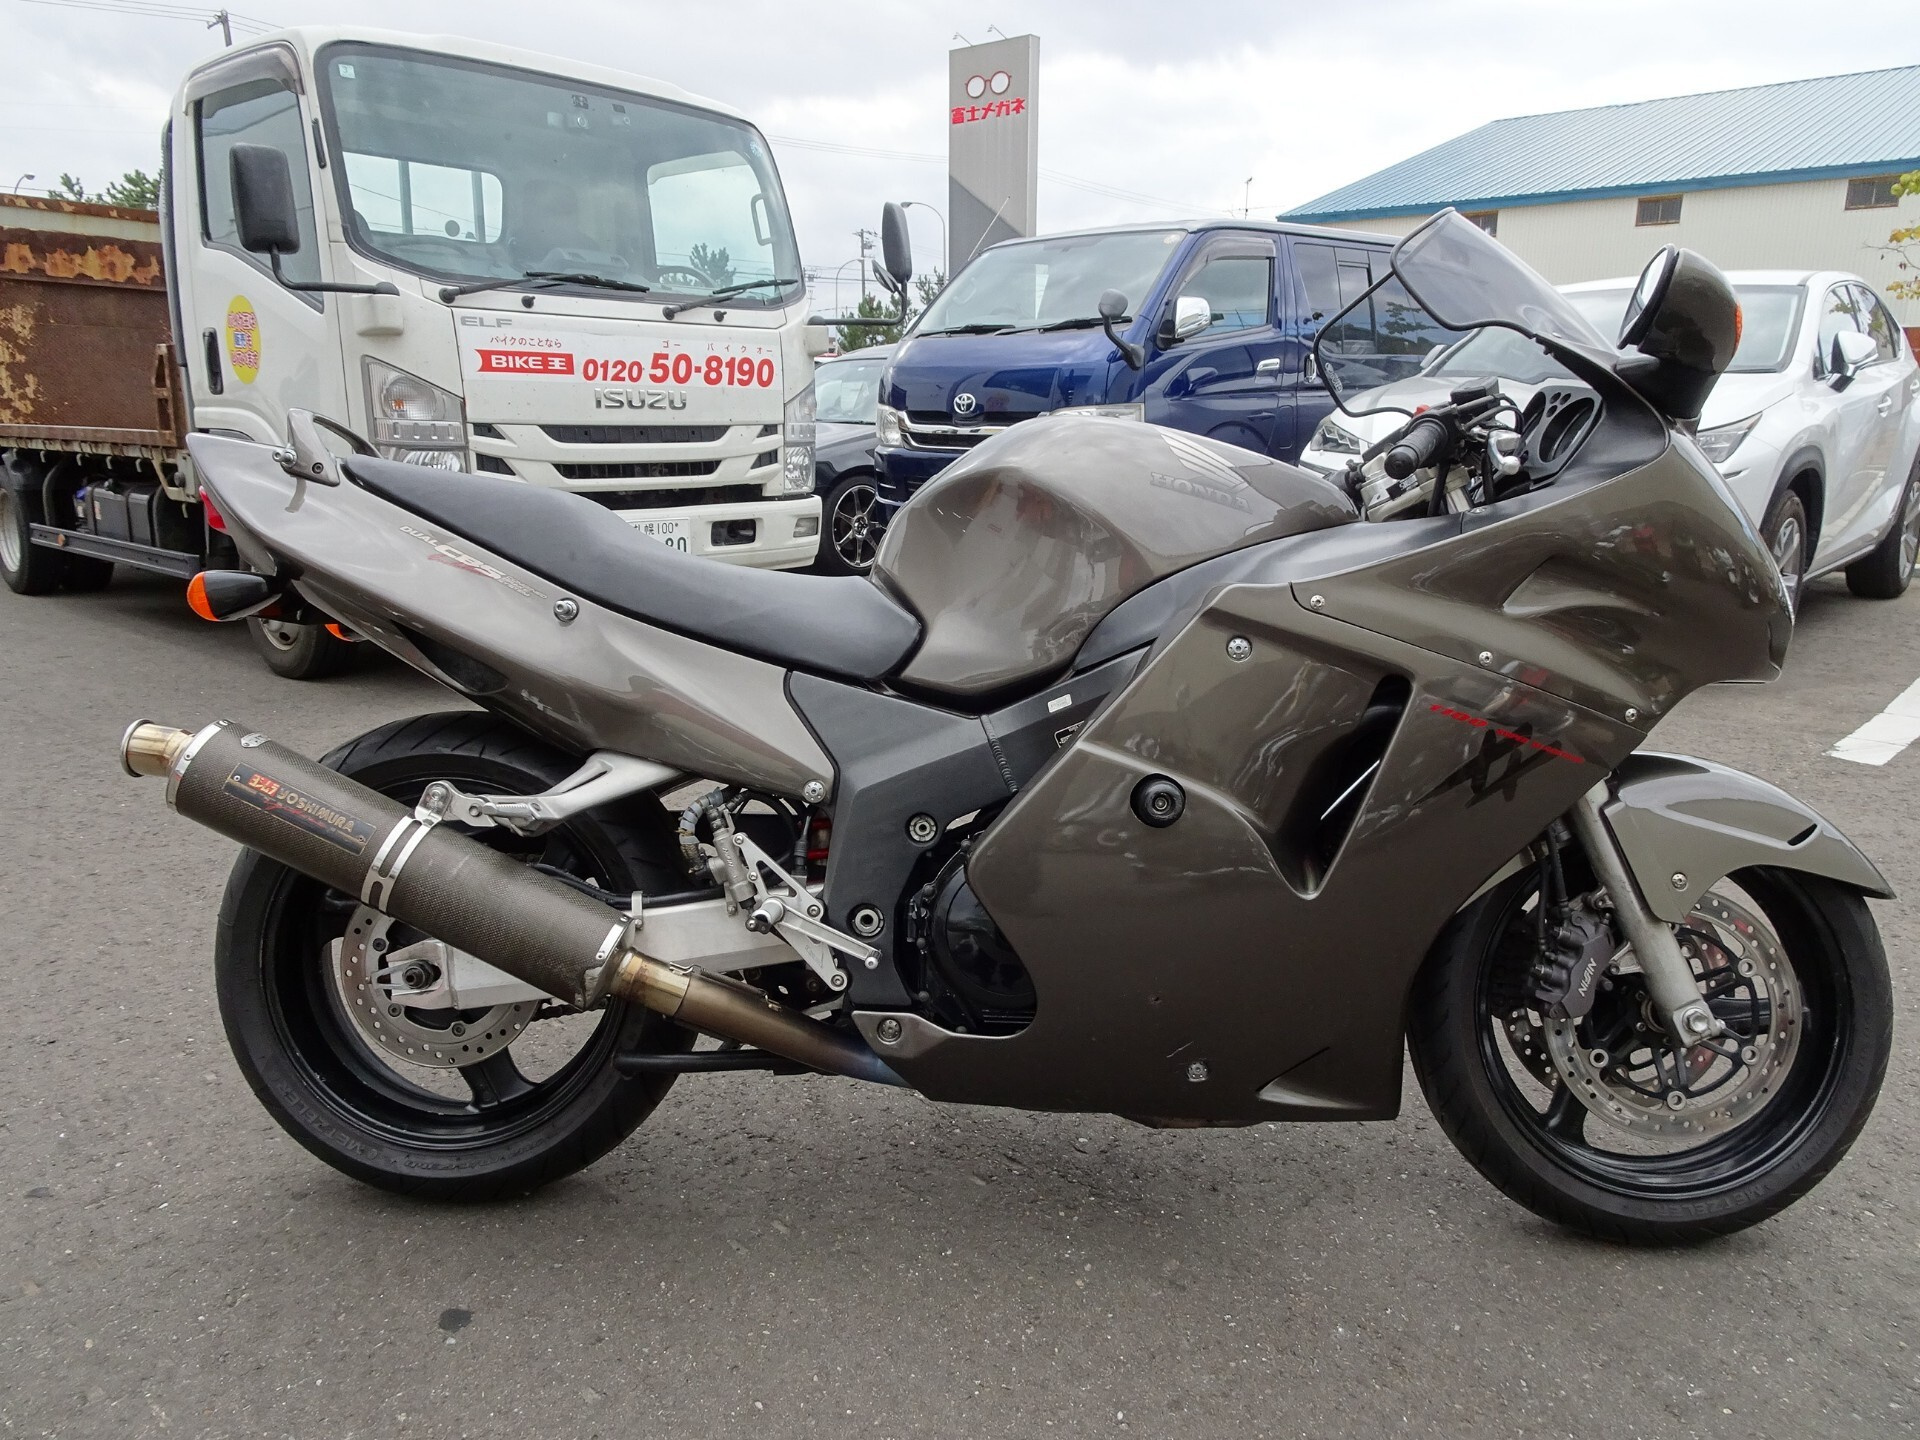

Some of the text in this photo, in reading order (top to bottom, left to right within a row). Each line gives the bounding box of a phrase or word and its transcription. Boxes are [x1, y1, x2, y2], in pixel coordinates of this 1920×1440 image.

[951, 98, 1026, 124] 富士メガネ
[460, 316, 512, 327] ELF
[490, 336, 562, 349] バイクのことなら
[491, 355, 567, 370] BIKE 王
[583, 352, 775, 388] 0120 50-8190
[594, 388, 687, 411] ISUZU
[1150, 472, 1253, 514] HONDA
[400, 525, 438, 547] DUAL
[435, 544, 506, 580] CBS
[277, 787, 355, 833] YOSHIMURA
